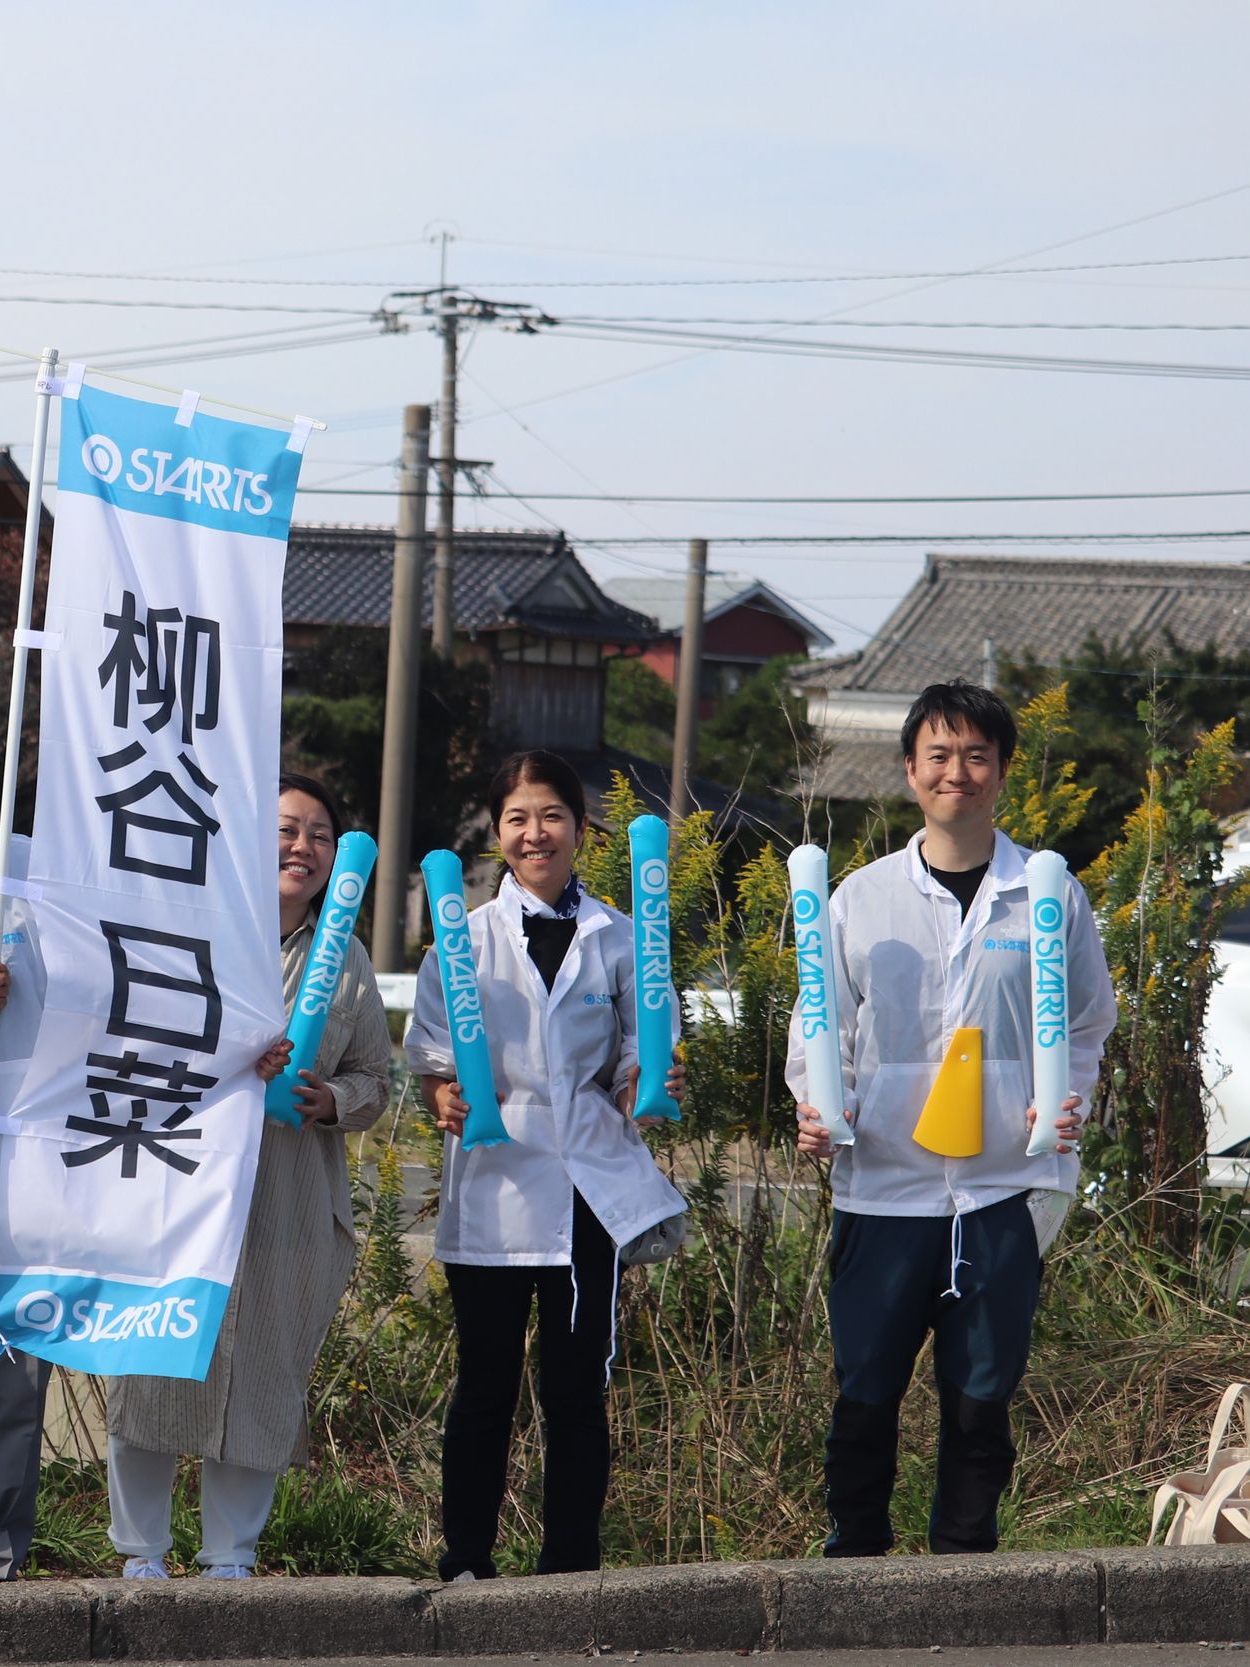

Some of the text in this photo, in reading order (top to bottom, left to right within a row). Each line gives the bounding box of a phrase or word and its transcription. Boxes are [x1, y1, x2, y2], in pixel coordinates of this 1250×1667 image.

[125, 447, 273, 516] STARTS
[60, 590, 222, 1179] 柳谷日菜
[300, 907, 355, 1018] STARTS
[442, 932, 485, 1045] STARTS
[641, 899, 671, 1011] STARTS
[796, 929, 828, 1041] STARTS
[1035, 937, 1066, 1050] STARTS
[64, 1297, 198, 1344] STARTS
